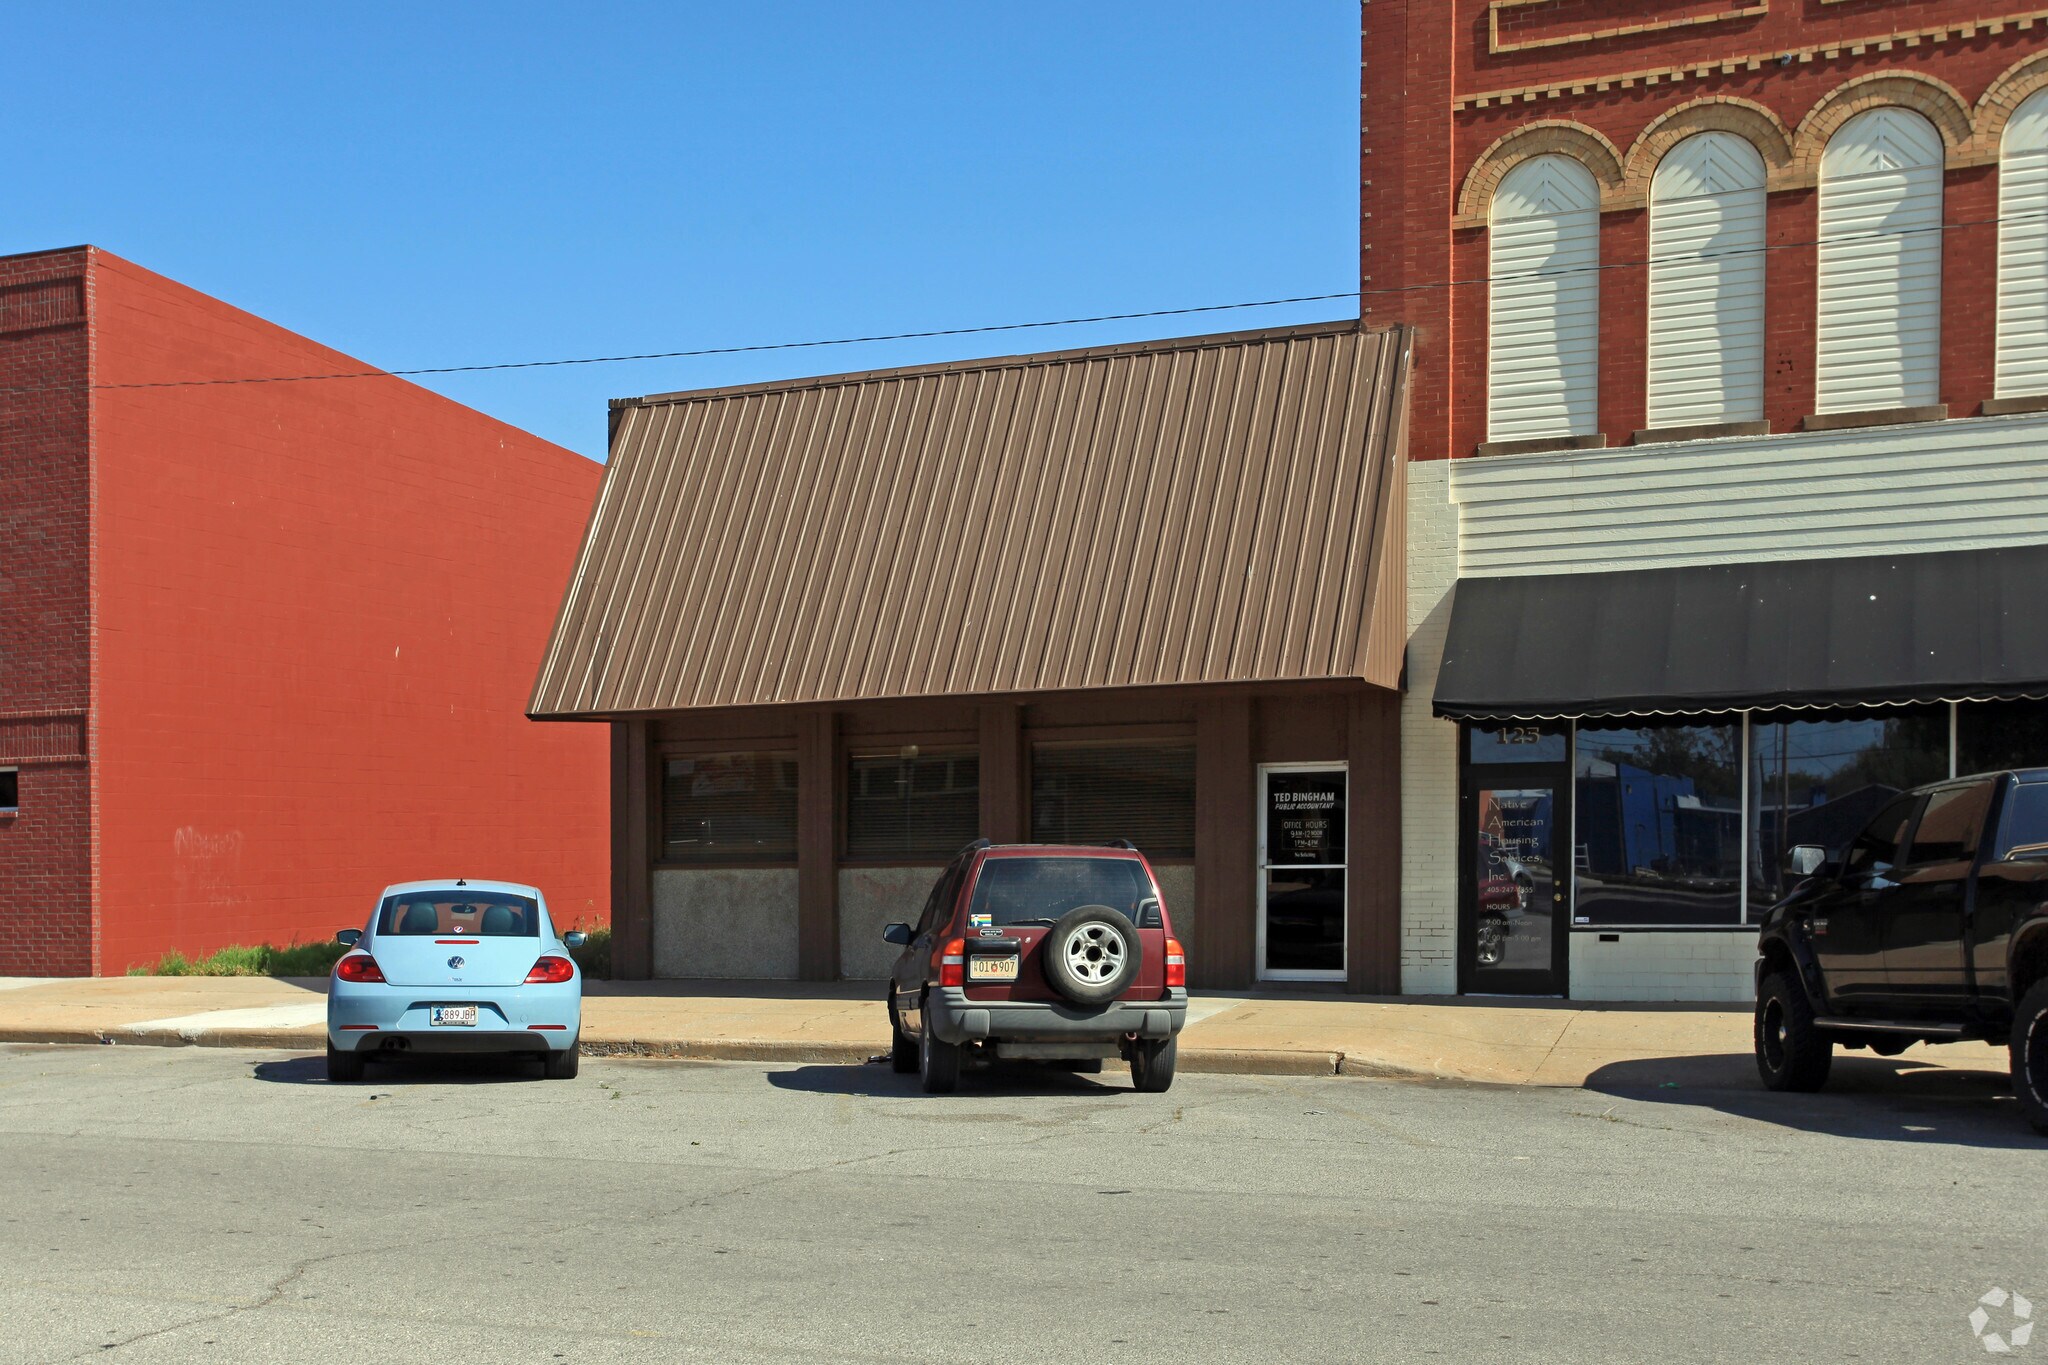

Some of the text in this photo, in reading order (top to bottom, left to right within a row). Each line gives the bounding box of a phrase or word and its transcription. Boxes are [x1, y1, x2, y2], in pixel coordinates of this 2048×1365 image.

[1497, 727, 1541, 745] 125
[1274, 792, 1335, 802] TED BINGHAM
[1296, 802, 1334, 810] ACCOUNTANT
[1488, 798, 1527, 811] Native
[1283, 821, 1328, 829] OFFICE HOURS
[1488, 816, 1544, 829] American
[1488, 833, 1539, 848] Housing
[1488, 869, 1508, 882] Inc.
